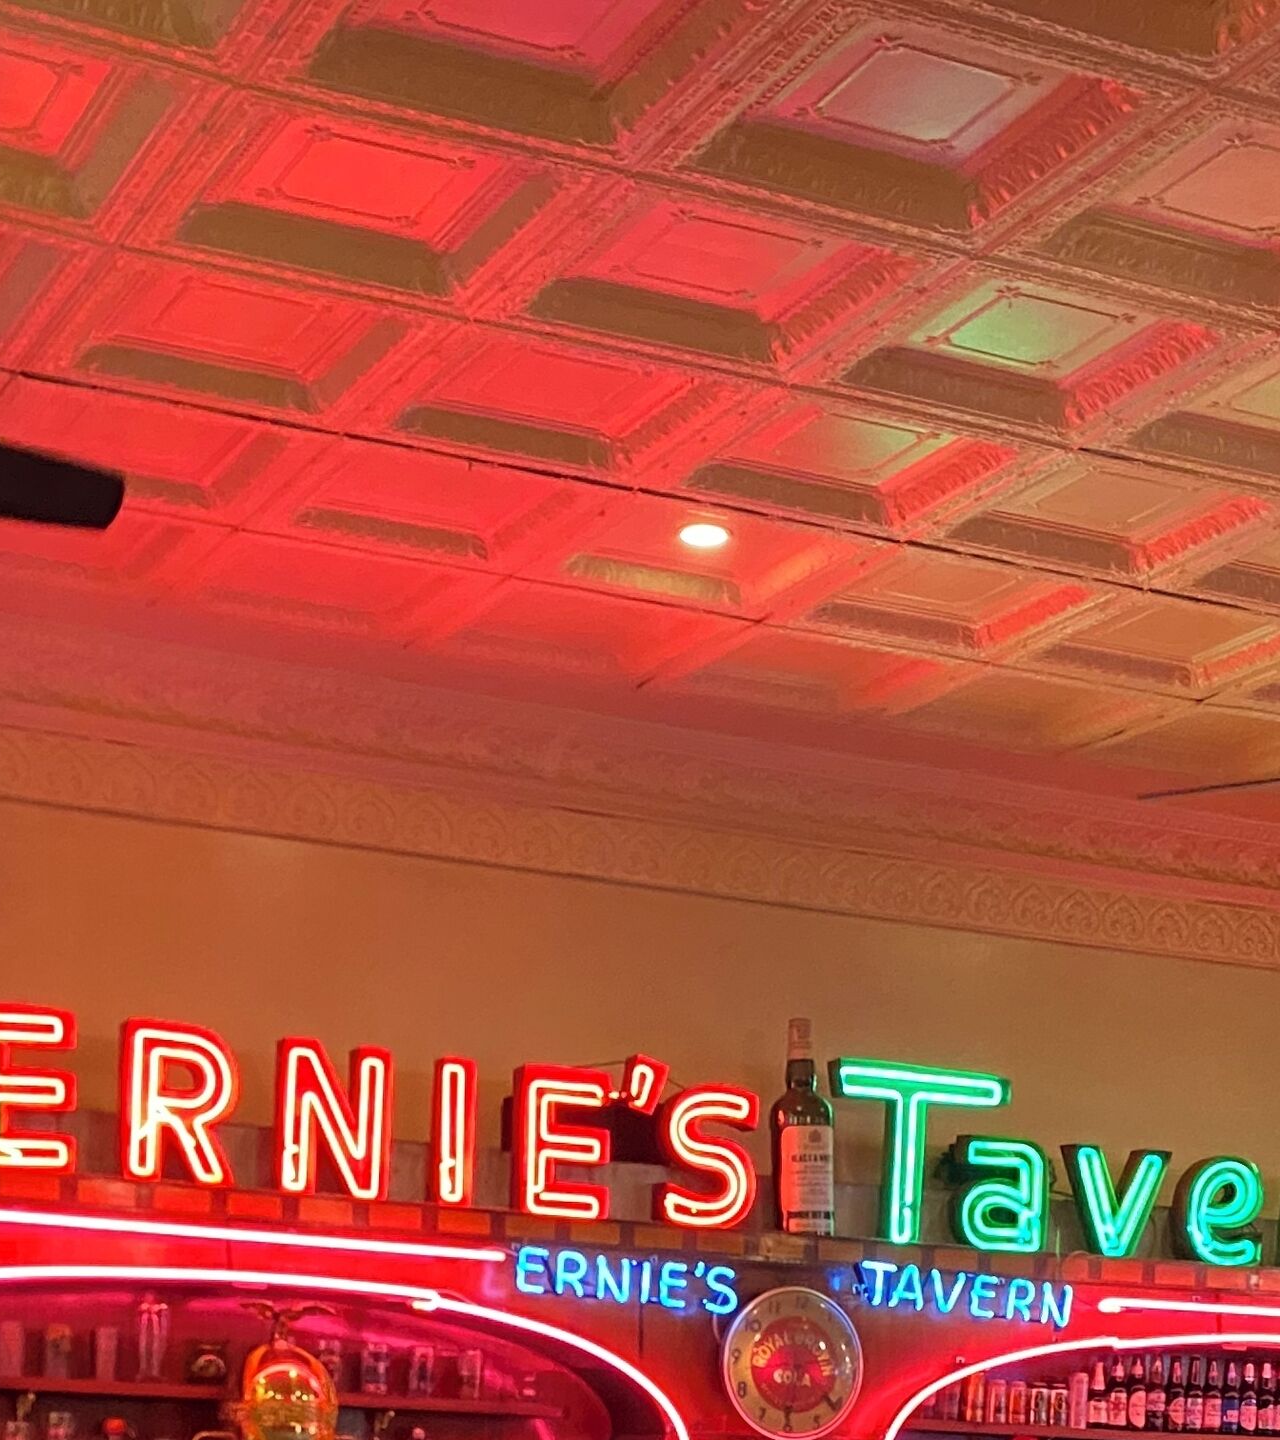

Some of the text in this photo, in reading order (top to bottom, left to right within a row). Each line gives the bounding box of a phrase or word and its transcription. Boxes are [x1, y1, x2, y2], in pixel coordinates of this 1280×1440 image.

[515, 1244, 740, 1316] ERNIE'S
[858, 1258, 1073, 1328] TAVERN
[751, 1330, 791, 1369] ROYAL
[772, 1367, 812, 1388] COLA
